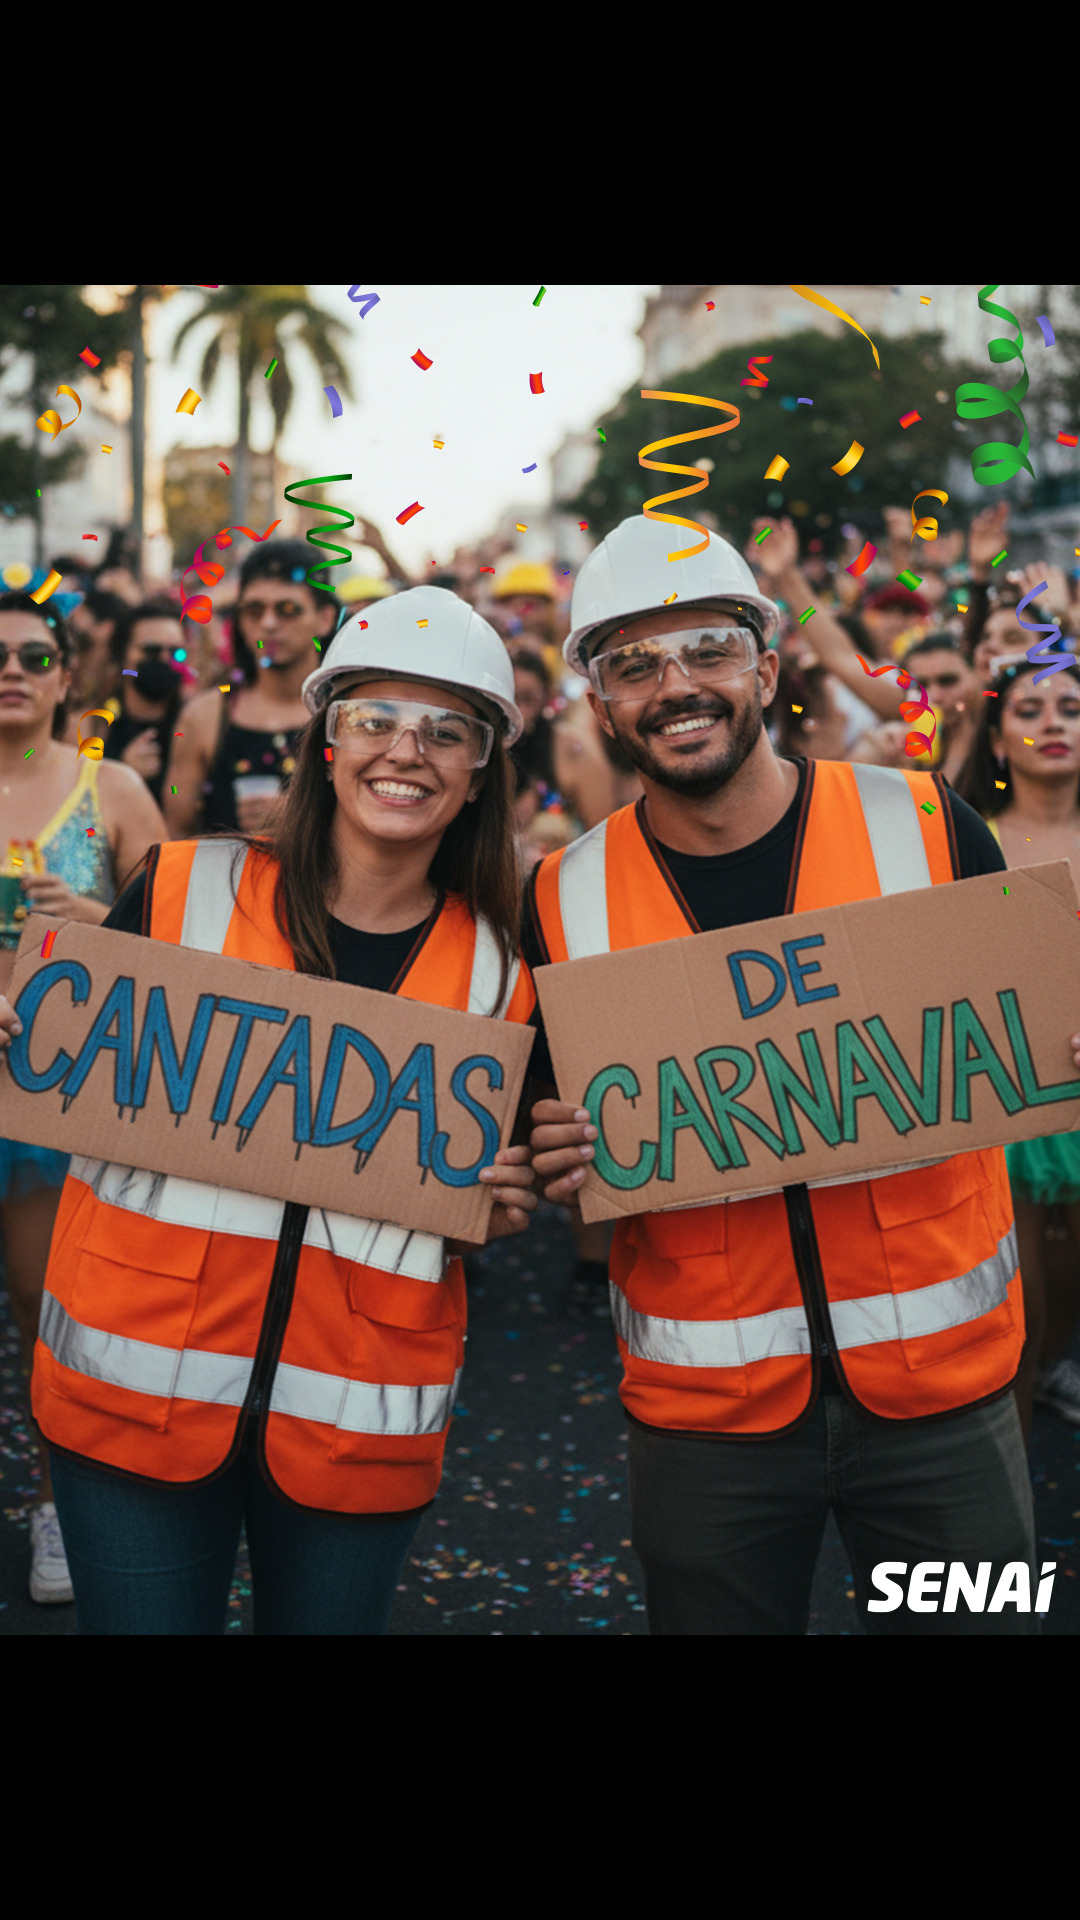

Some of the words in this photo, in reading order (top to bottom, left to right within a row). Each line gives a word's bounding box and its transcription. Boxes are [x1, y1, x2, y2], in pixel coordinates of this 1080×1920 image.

[6, 960, 504, 1187] CANTADAS
[726, 933, 839, 1020] DE
[583, 989, 1080, 1191] CARNAVAL
